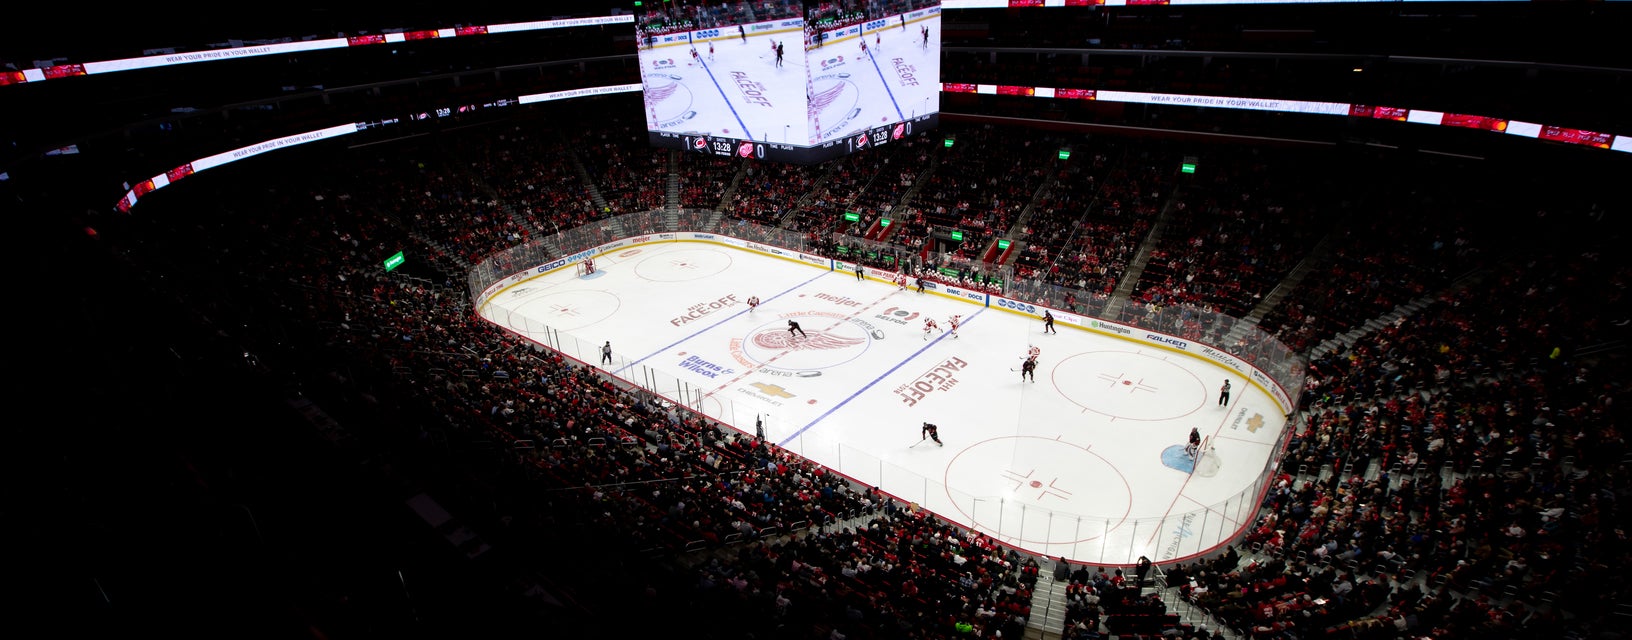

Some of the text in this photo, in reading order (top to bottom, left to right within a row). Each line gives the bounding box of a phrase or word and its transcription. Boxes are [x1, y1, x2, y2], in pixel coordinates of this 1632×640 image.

[1248, 100, 1279, 108] WALLET
[906, 122, 911, 135] 0
[684, 136, 690, 150] 1
[873, 131, 888, 142] 13:28
[233, 150, 248, 158] WEAR
[262, 142, 276, 150] PRIDE
[302, 132, 323, 140] WALLET
[713, 141, 731, 152] 13:28
[757, 144, 764, 158] 0
[847, 138, 852, 152] 1
[632, 236, 650, 244] meijer
[538, 259, 566, 273] GEICO
[814, 292, 863, 308] meijer
[670, 293, 737, 327] FACE-OFF
[778, 310, 806, 319] Little
[807, 310, 846, 319] Caesars
[875, 314, 908, 326] BELFOR
[1099, 322, 1131, 334] Huntington
[1147, 334, 1187, 347] FALKEN
[678, 360, 719, 379] Wilcox
[686, 355, 735, 375] Burns &
[760, 368, 792, 377] arena
[900, 356, 968, 407] FACE-OFF
[938, 378, 959, 392] NHL
[737, 387, 784, 407] CHEVROLET
[1184, 513, 1196, 526] PURE
